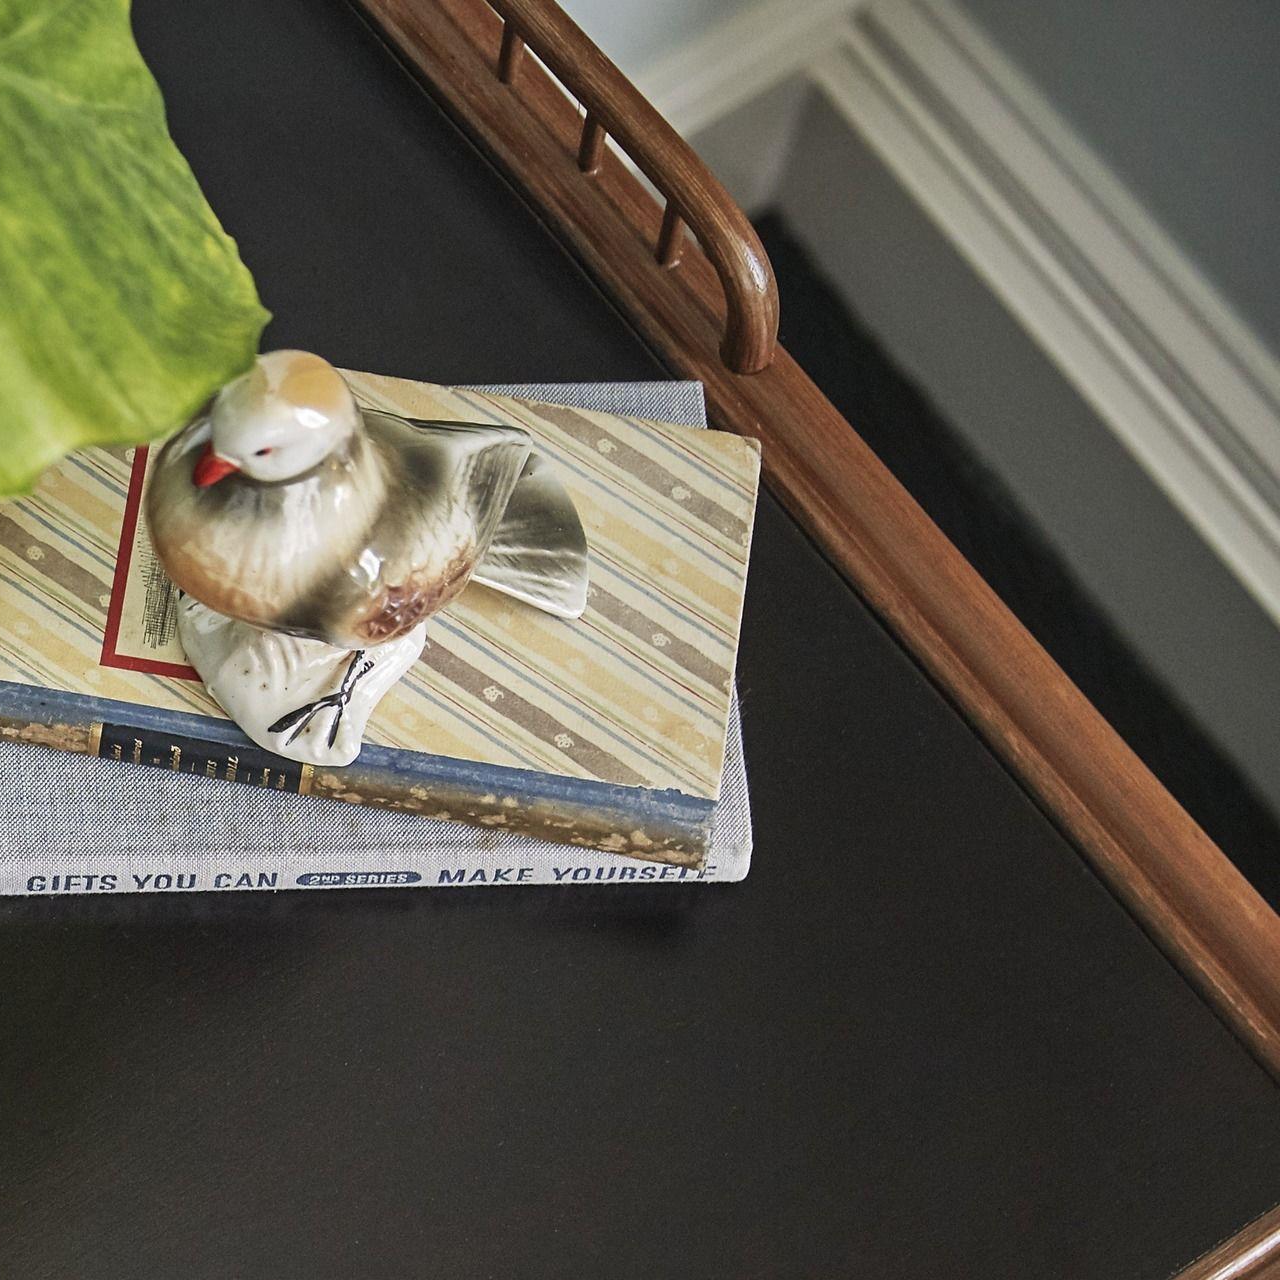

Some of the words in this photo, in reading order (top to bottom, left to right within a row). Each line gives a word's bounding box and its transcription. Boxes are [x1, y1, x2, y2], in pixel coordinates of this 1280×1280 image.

[26, 874, 118, 892] GIFTS
[132, 873, 197, 891] YOU
[213, 872, 279, 889] CAN
[308, 874, 340, 886] 2ND
[344, 873, 408, 886] SERIES
[437, 867, 533, 884] MAKE
[552, 865, 717, 882] YOURSELF
